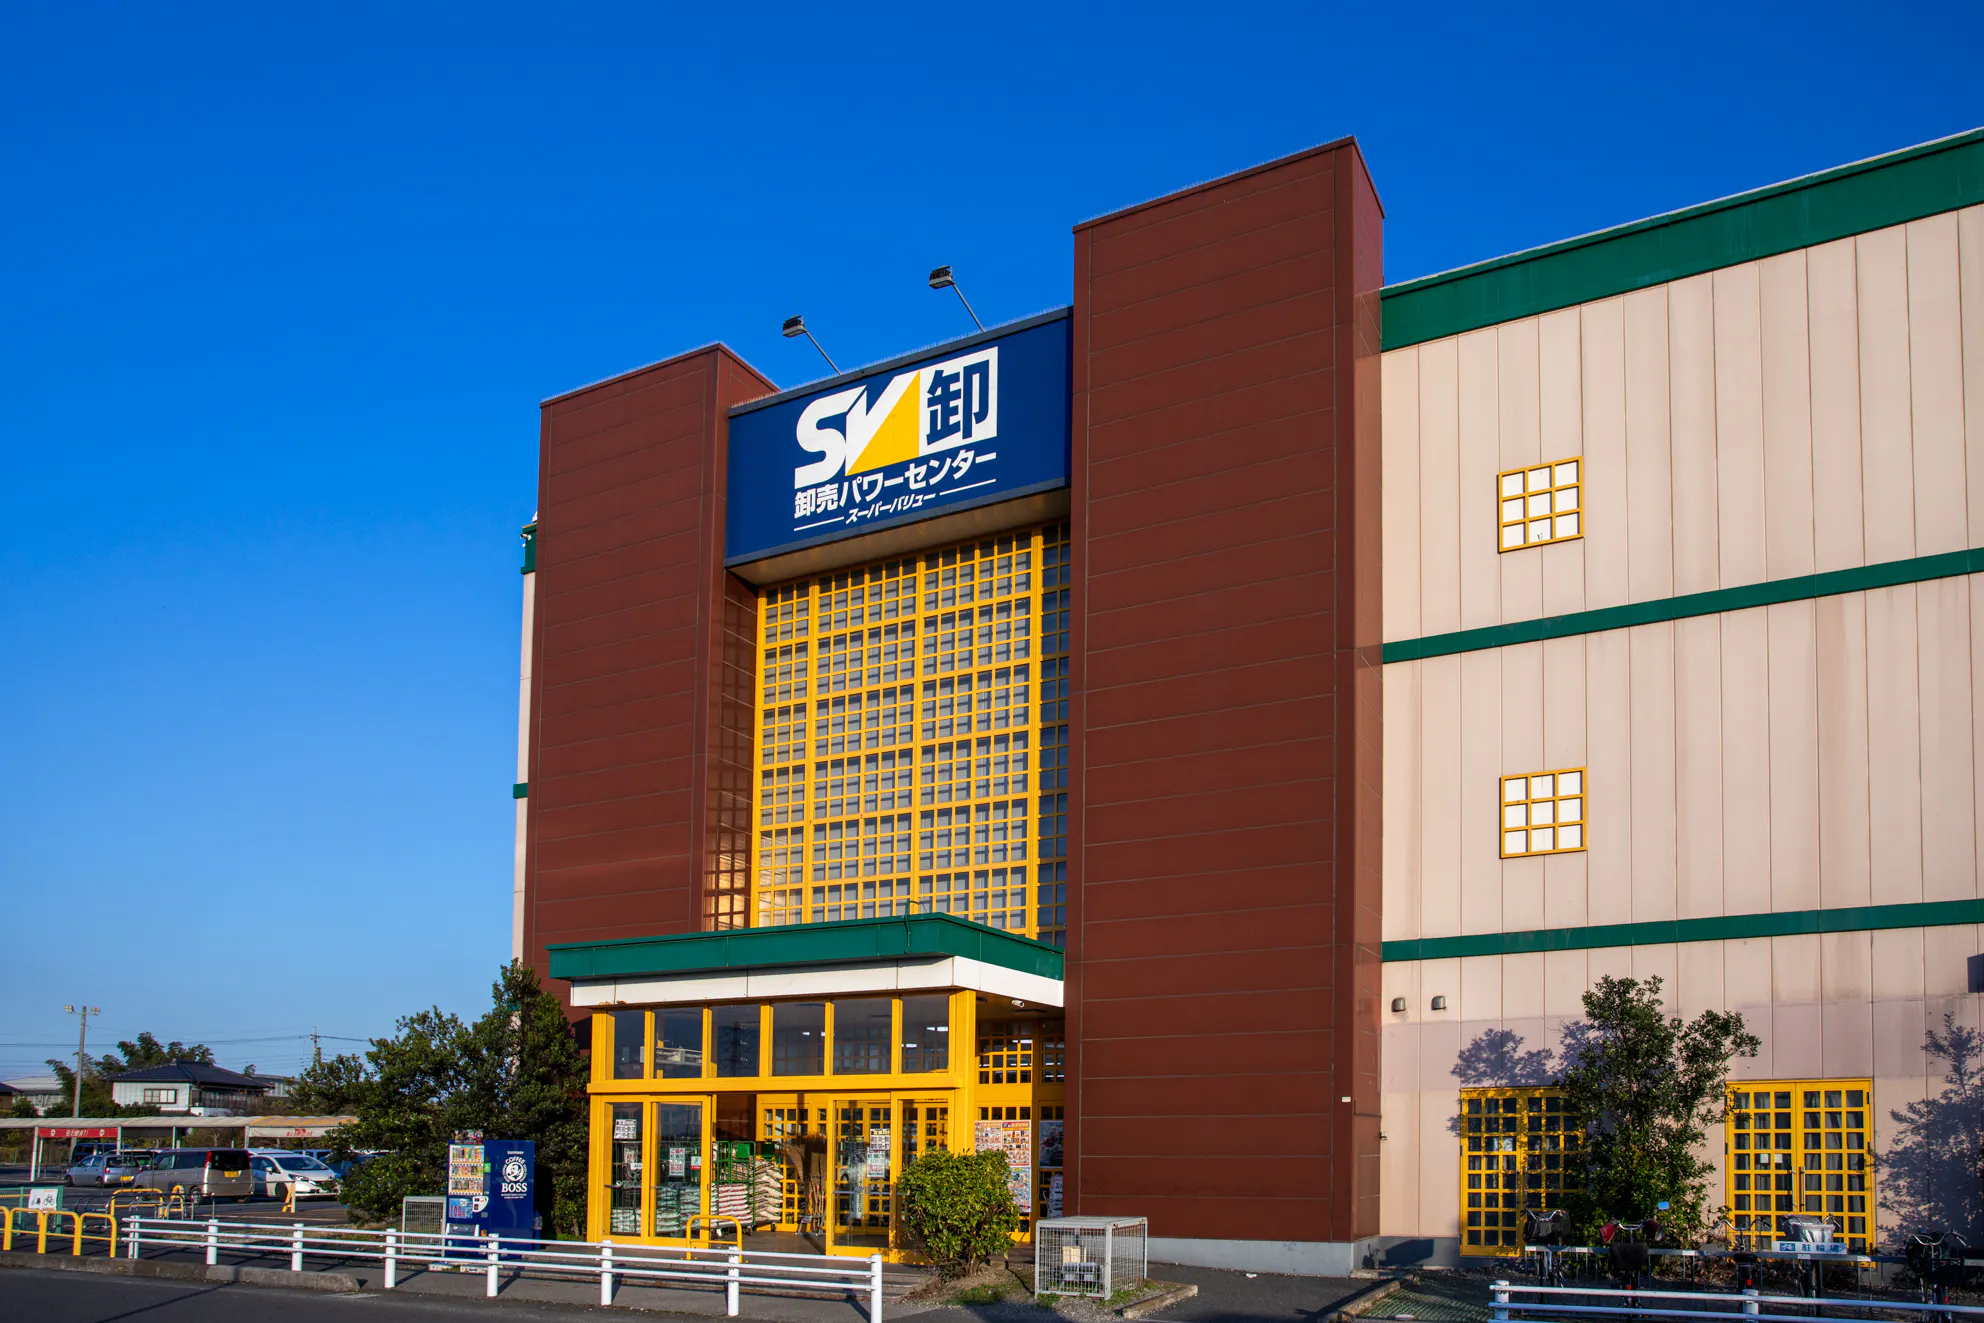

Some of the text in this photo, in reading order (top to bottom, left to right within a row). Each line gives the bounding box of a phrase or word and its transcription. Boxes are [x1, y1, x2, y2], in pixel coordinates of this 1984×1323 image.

[926, 359, 990, 446] 卸
[794, 449, 997, 519] 卸売パワーセンター
[845, 493, 937, 525] スーパーバリュー
[505, 1156, 526, 1165] COFFEE
[501, 1182, 528, 1193] BOSS
